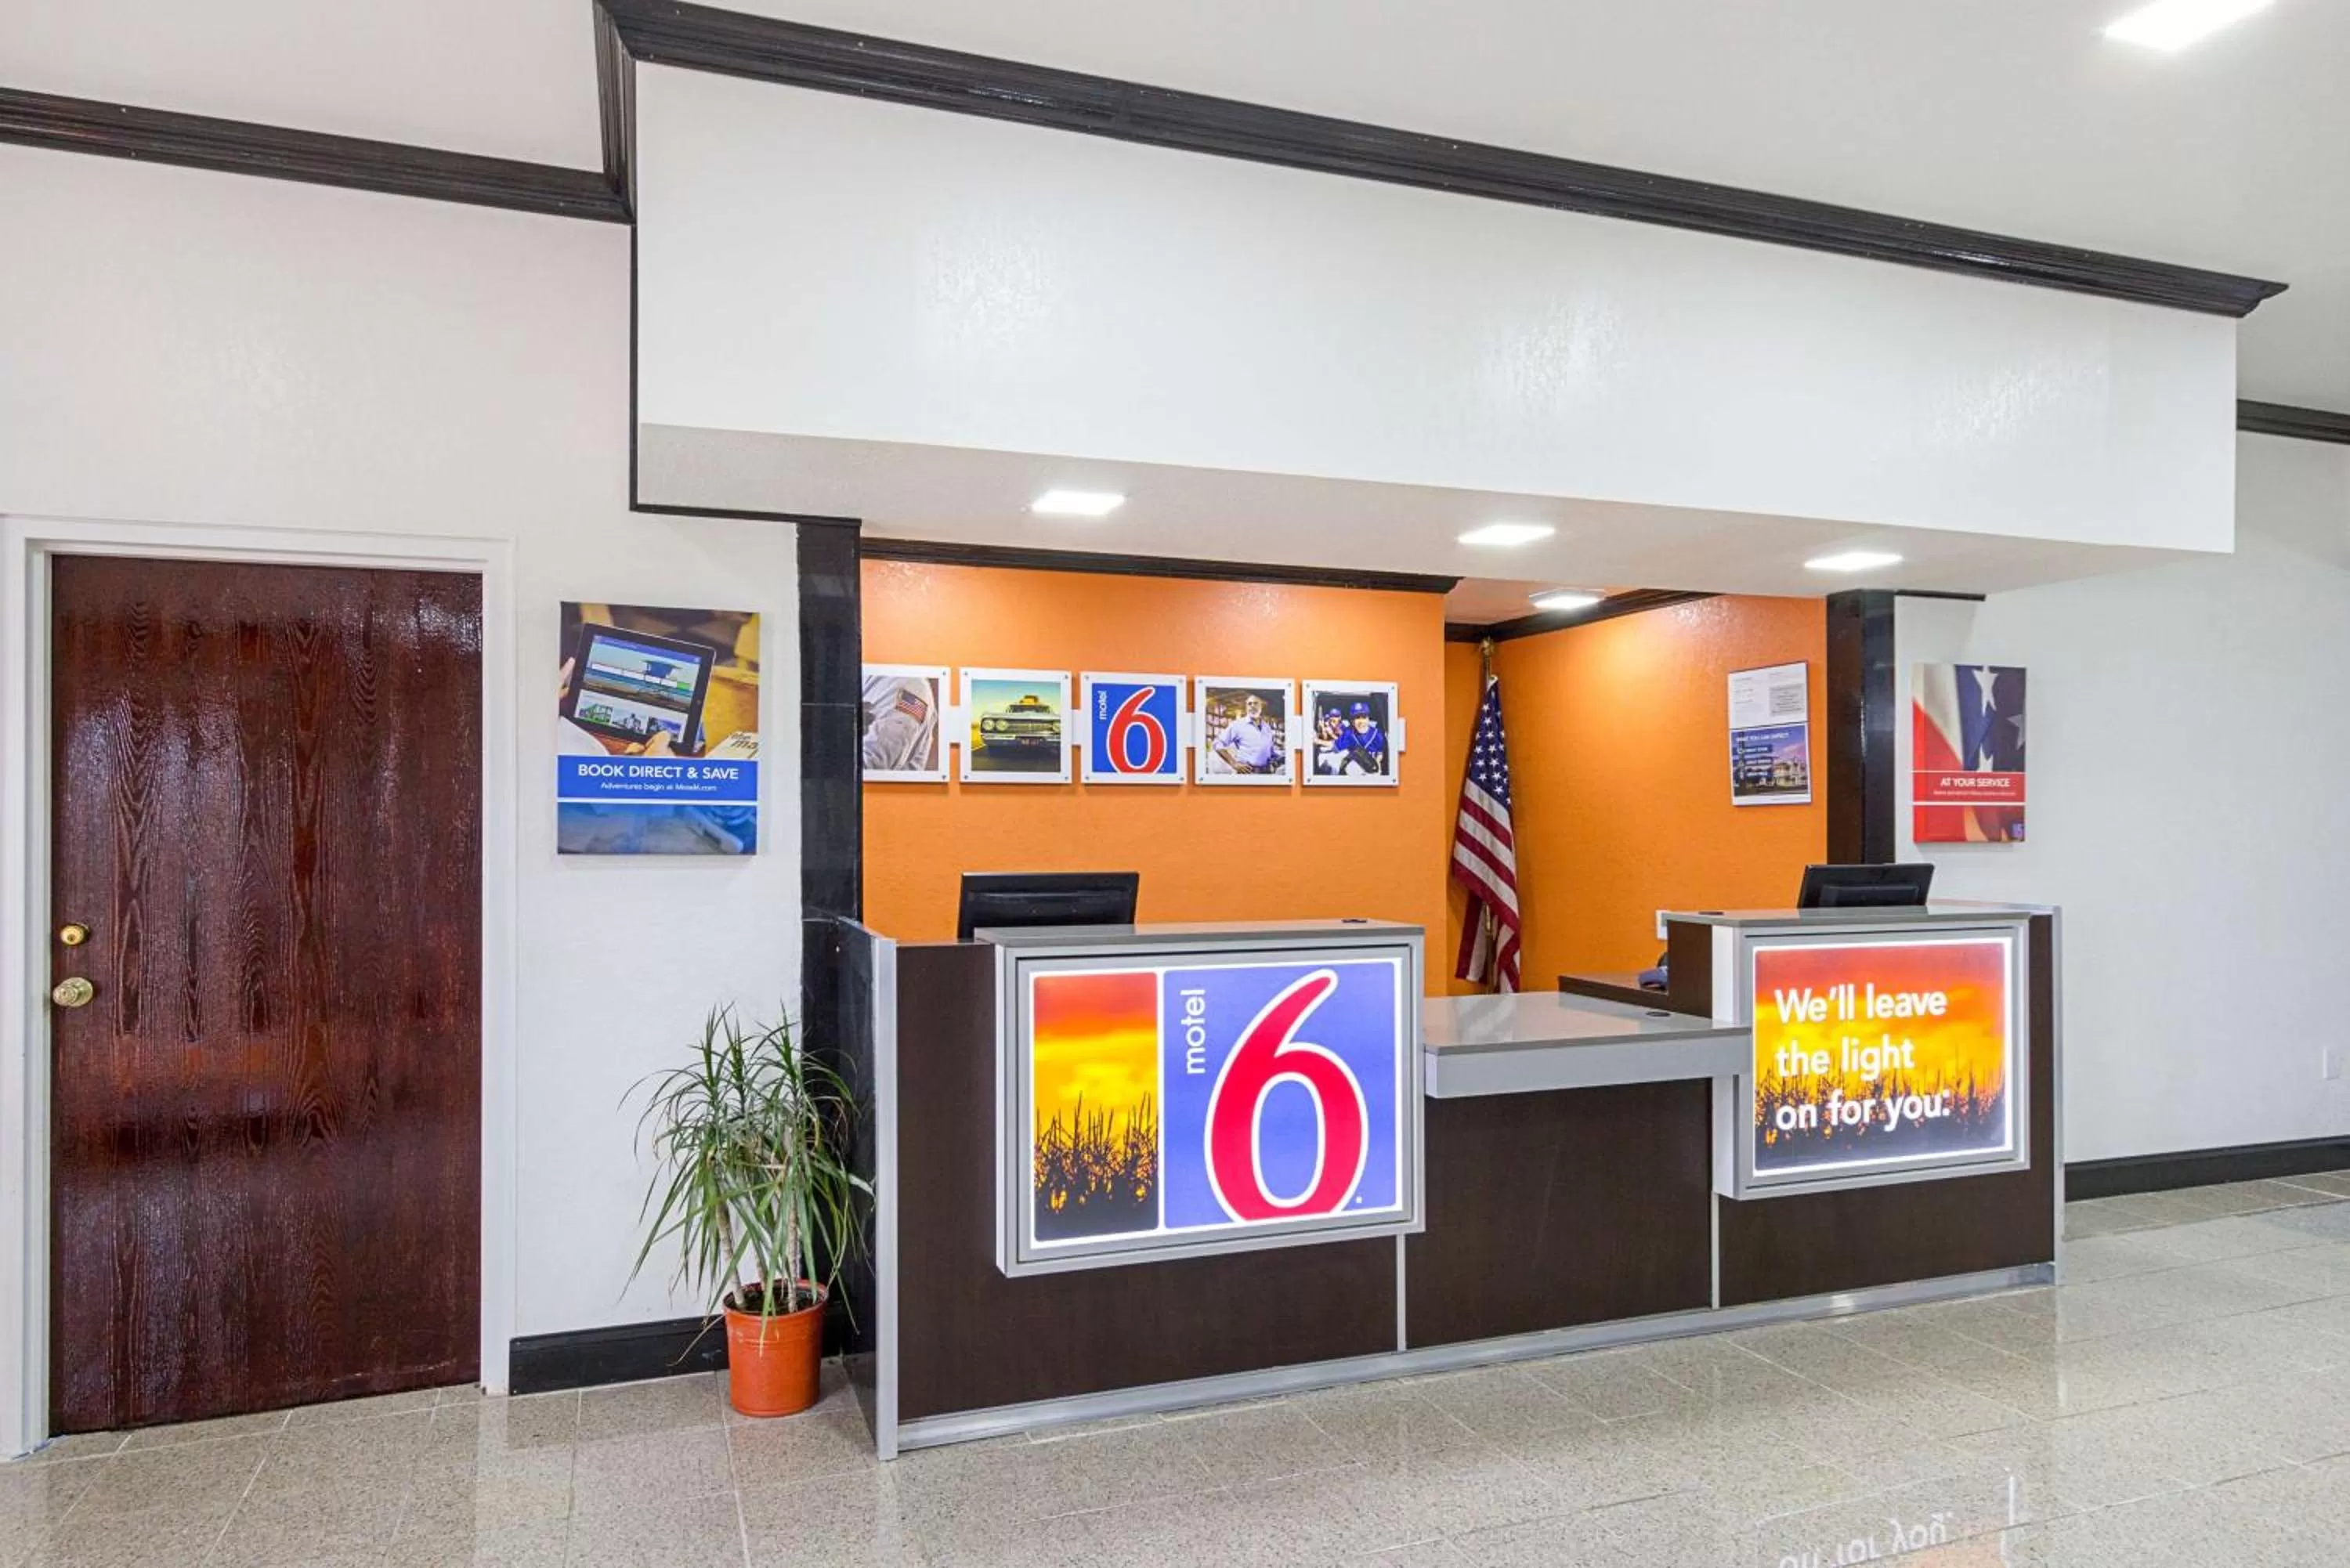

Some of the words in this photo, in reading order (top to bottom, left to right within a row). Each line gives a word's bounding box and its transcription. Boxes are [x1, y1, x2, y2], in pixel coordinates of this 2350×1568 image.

[1106, 686, 1167, 775] 6
[578, 764, 624, 777] BOOK
[629, 765, 683, 779] DIRECT
[687, 767, 699, 779] &
[703, 768, 739, 780] SAVE
[1940, 777, 1950, 787] AT
[1952, 777, 1976, 787] YOUR
[1976, 778, 2011, 788] SERVICE
[1773, 984, 1855, 1024] We'll
[1866, 983, 1948, 1019] leave
[1775, 1039, 1830, 1077] the
[1841, 1034, 1915, 1081] light
[1180, 988, 1206, 1075] motel
[1203, 968, 1369, 1223] 6
[1775, 1102, 1817, 1131] on
[1829, 1089, 1877, 1126] for
